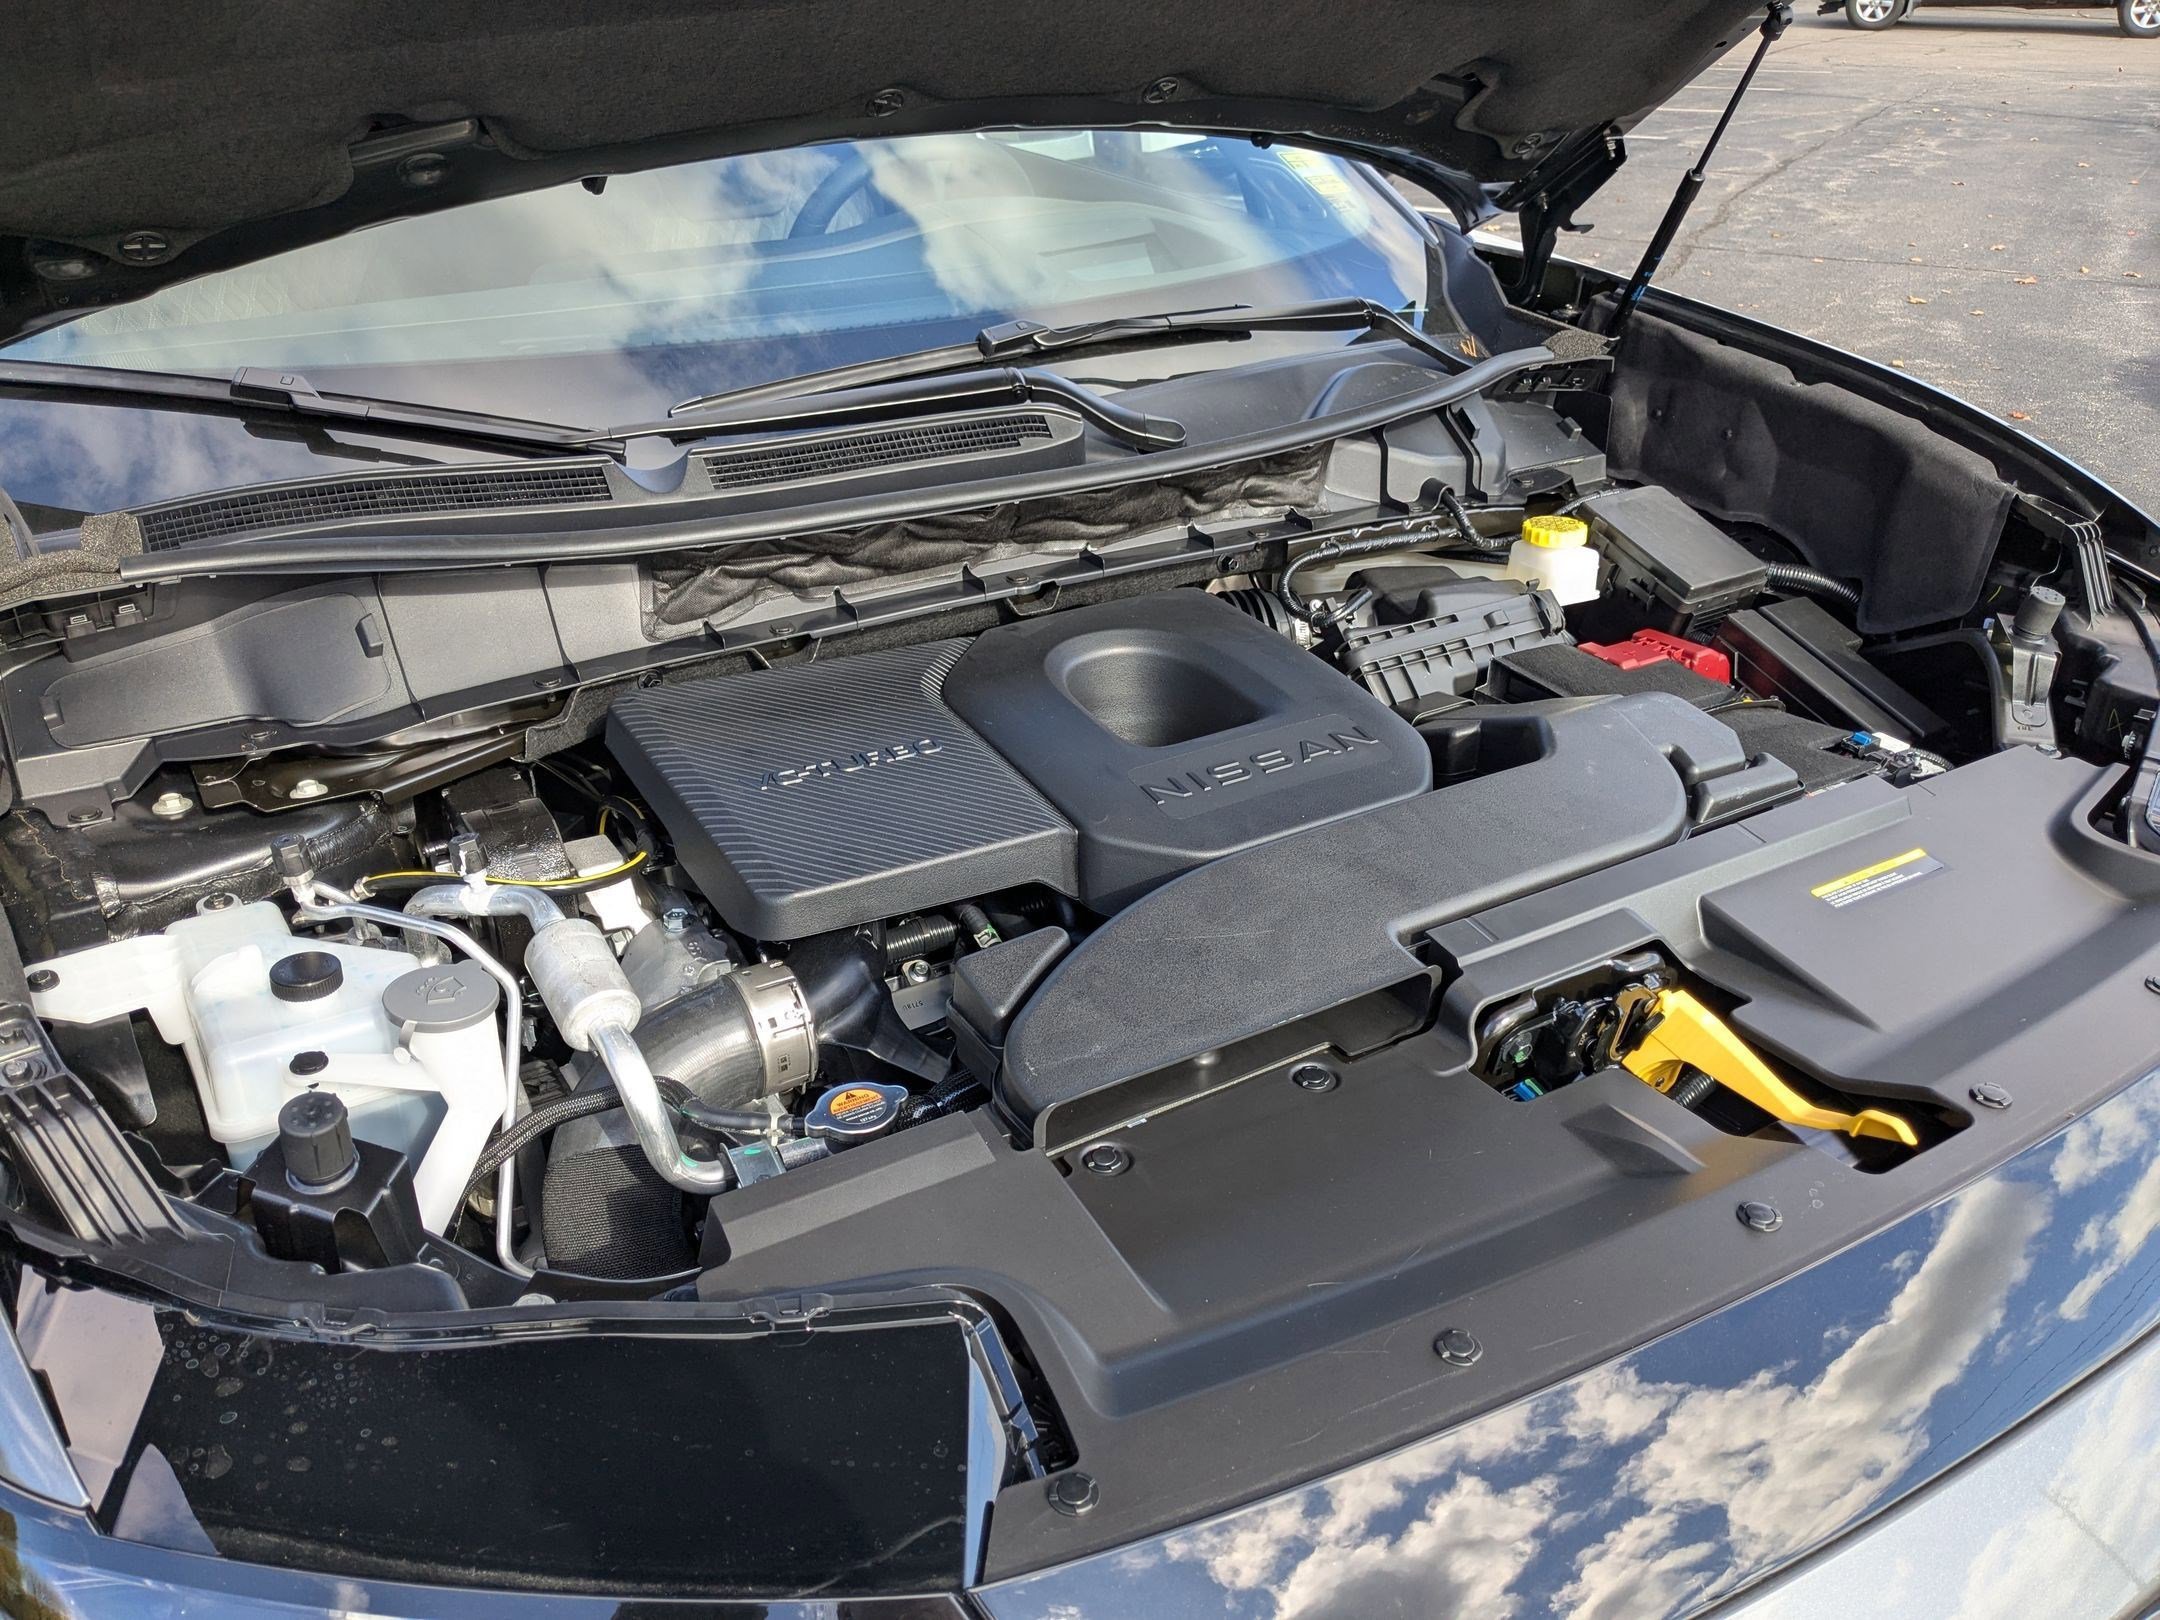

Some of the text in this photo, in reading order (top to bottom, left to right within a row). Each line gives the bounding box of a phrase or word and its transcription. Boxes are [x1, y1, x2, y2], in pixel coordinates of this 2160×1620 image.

[749, 737, 944, 791] VC-TURBO
[1140, 725, 1379, 805] NISSAN
[836, 1093, 870, 1107] WARNING
